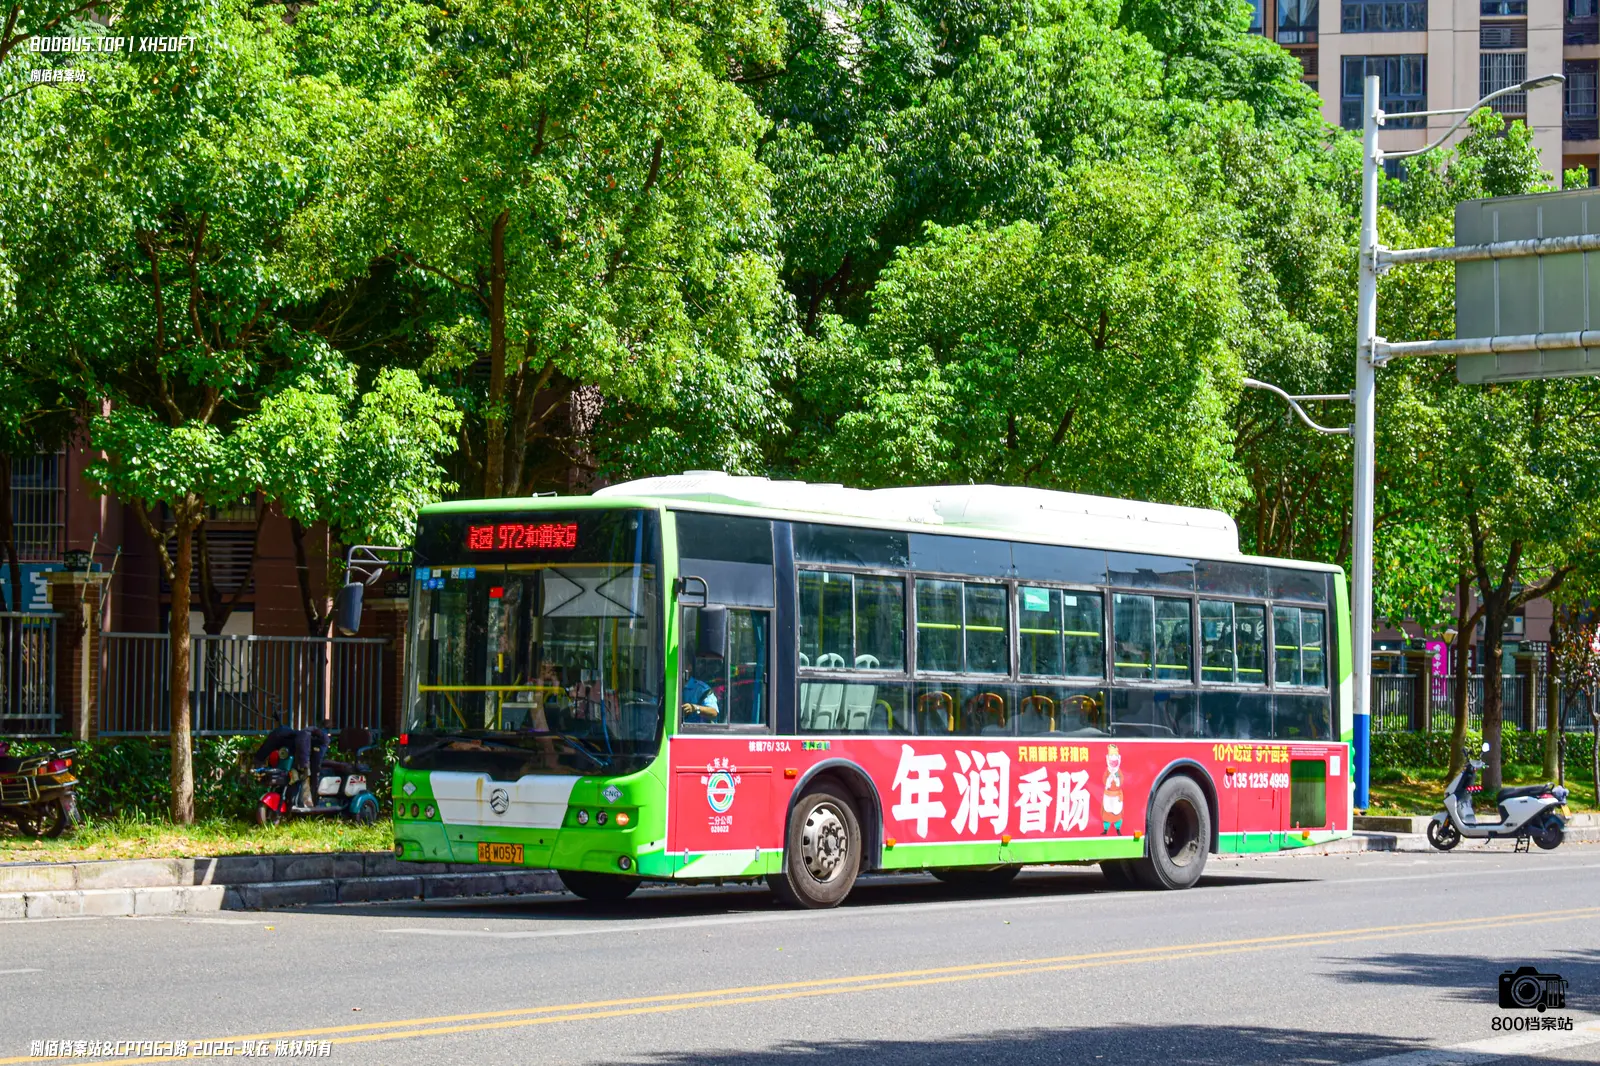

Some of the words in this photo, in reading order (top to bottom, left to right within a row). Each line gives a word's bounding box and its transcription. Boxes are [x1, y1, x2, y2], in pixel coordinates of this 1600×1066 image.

[1018, 746, 1058, 762] 只用新鲜
[1060, 746, 1089, 762] 好猪肉
[1212, 744, 1252, 762] 10个吃过
[1256, 744, 1289, 763] 9个回头
[1232, 773, 1247, 788] 135
[1248, 773, 1268, 788] 1235
[1269, 773, 1289, 788] 4999
[708, 816, 733, 825] 二分公司
